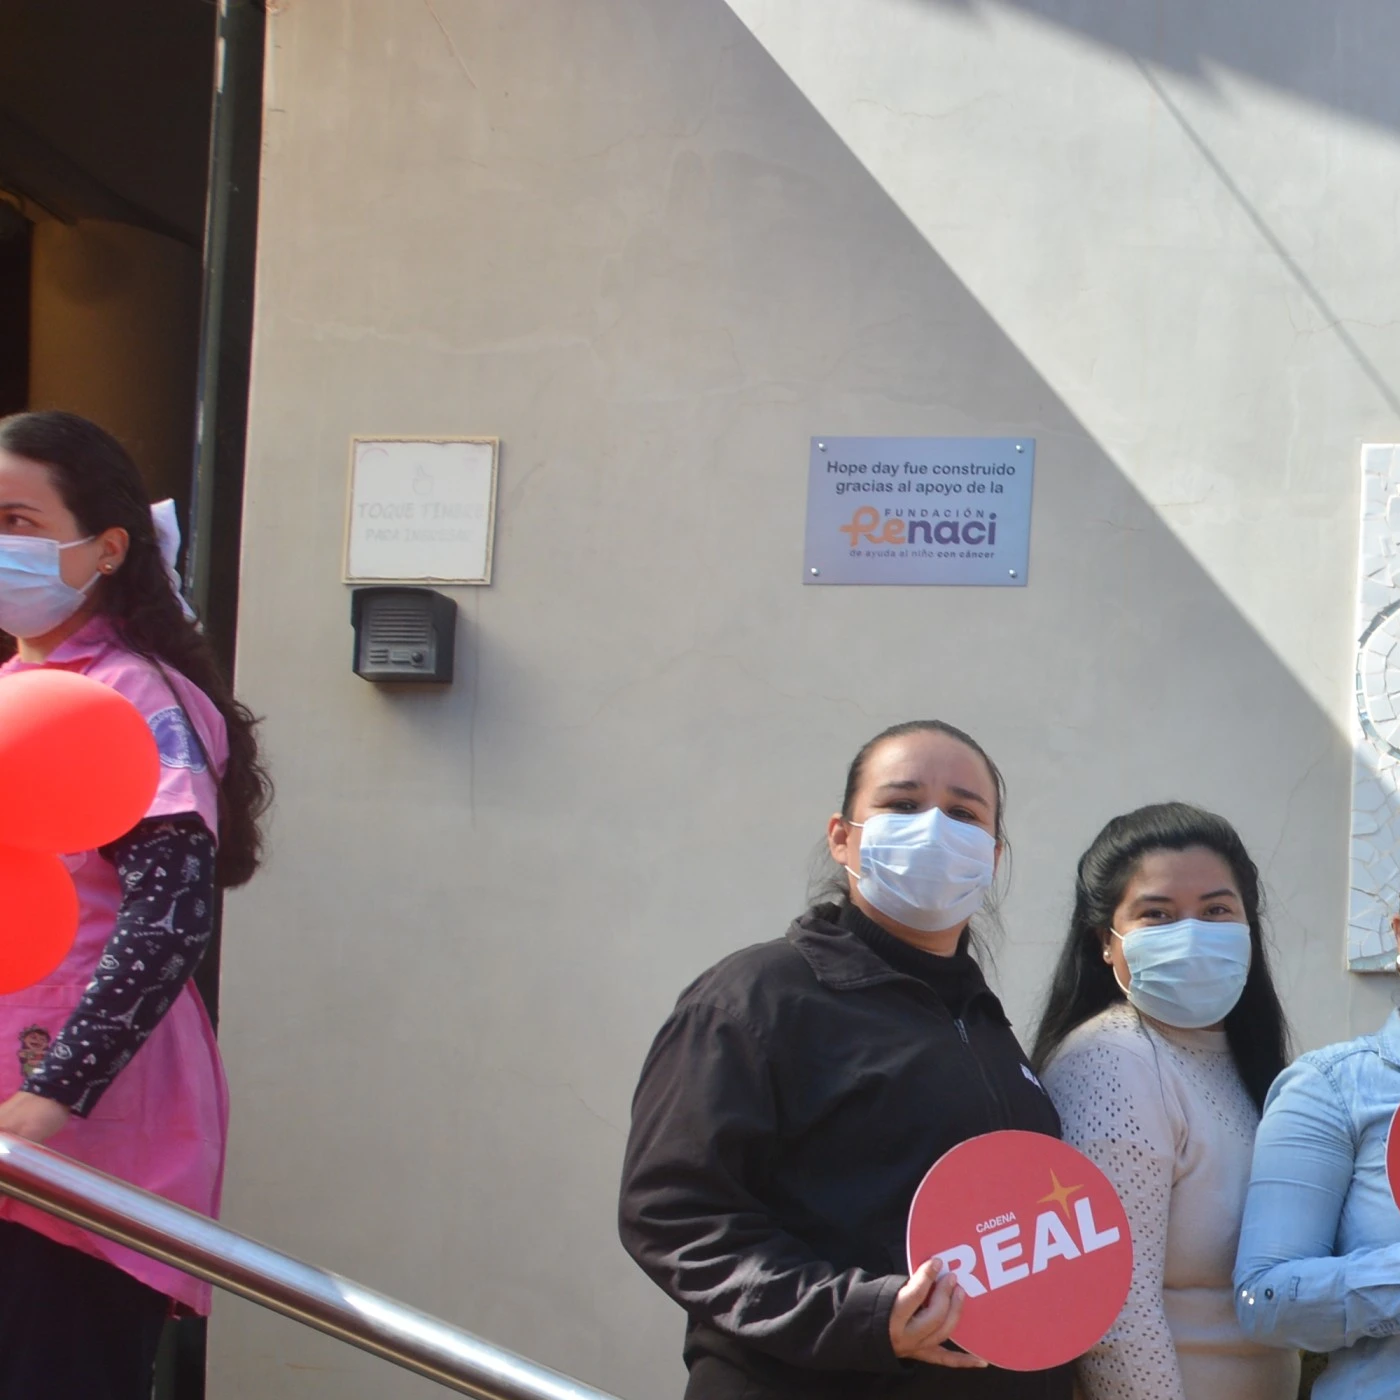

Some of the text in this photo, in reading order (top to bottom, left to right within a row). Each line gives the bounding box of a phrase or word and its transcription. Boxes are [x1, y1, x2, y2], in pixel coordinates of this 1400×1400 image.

[827, 461, 1015, 477] Hope day fue construido
[836, 480, 1004, 496] gracias al apoyo de la
[884, 508, 985, 518] FUNDACIÓN
[839, 505, 997, 547] Renaci
[849, 549, 862, 558] de
[865, 549, 896, 560] ayuda
[959, 550, 995, 559] cáncer
[975, 1211, 1016, 1233] CADENA
[931, 1196, 1120, 1298] REAL
